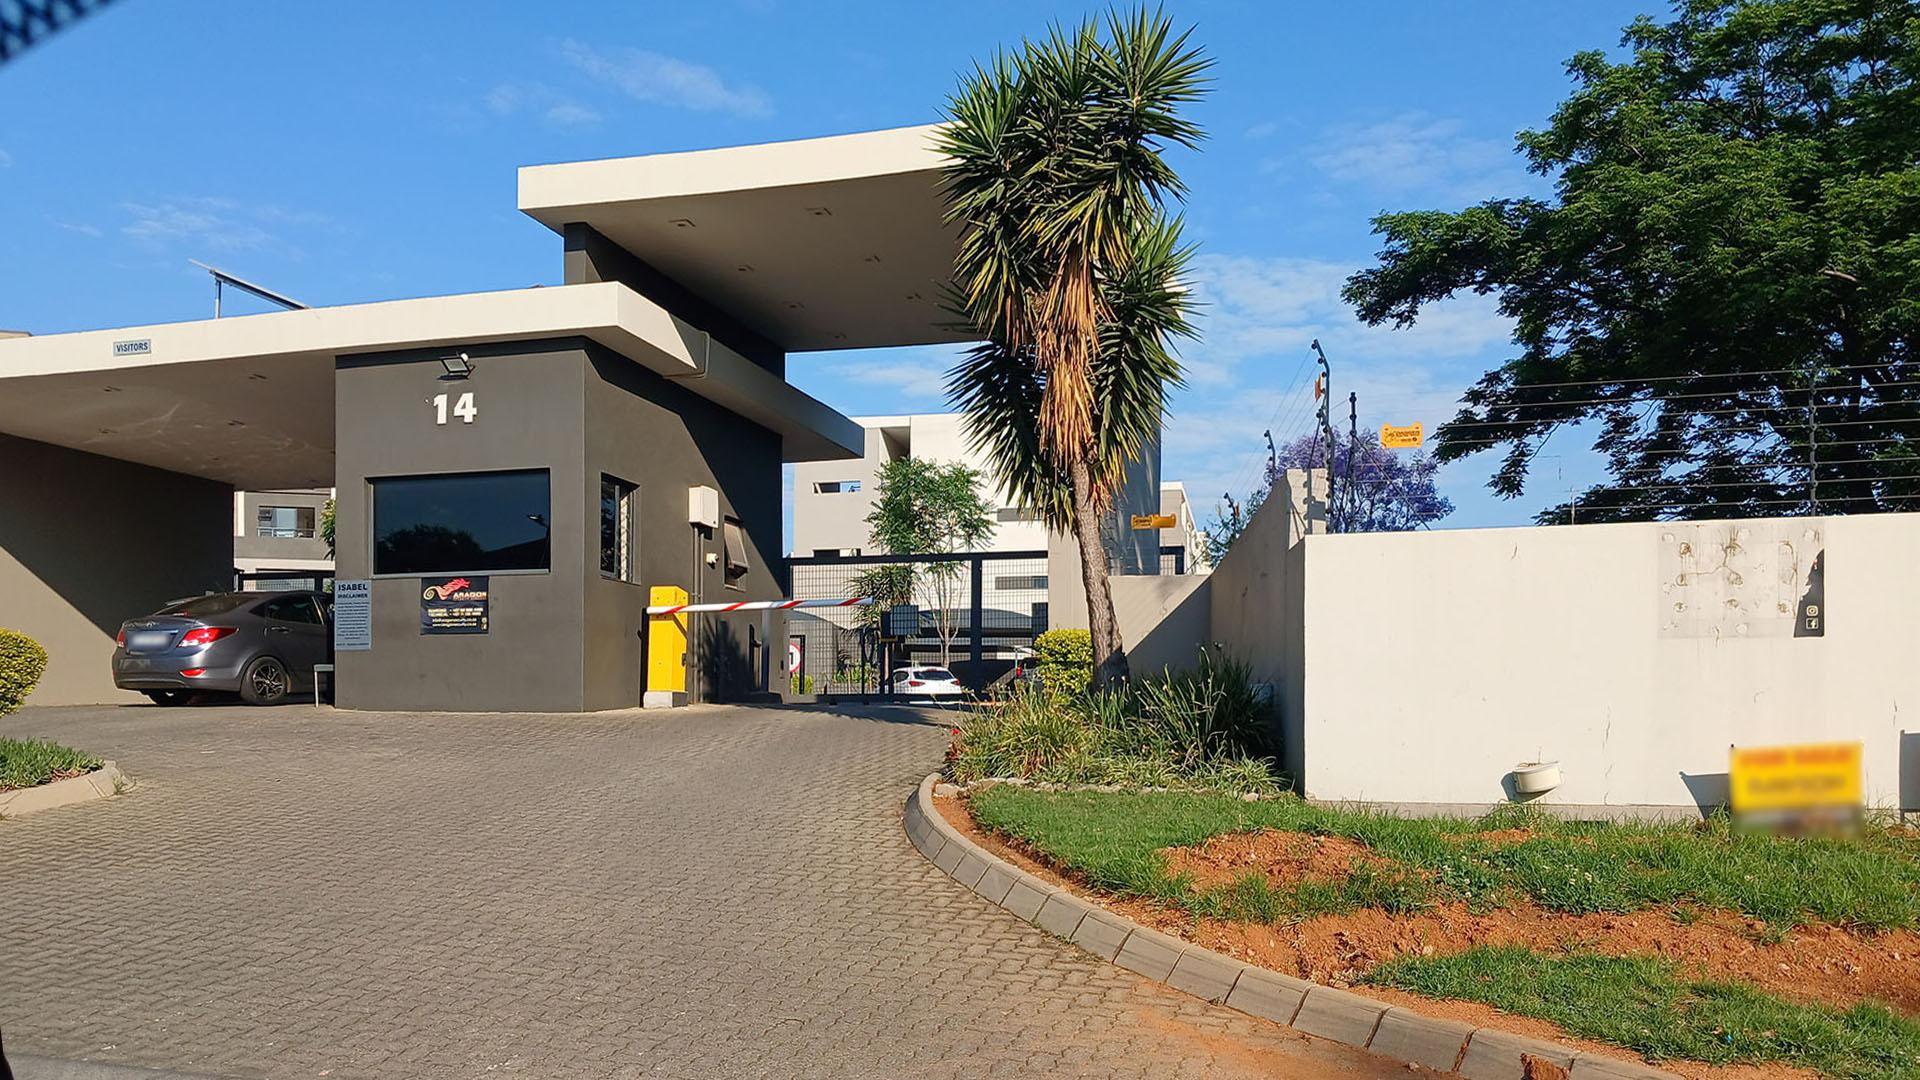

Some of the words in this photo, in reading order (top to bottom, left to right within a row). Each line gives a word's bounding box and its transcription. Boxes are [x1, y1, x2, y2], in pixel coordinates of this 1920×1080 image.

[116, 341, 149, 353] VISITORS
[434, 392, 477, 425] 14
[338, 583, 368, 591] ISABEL
